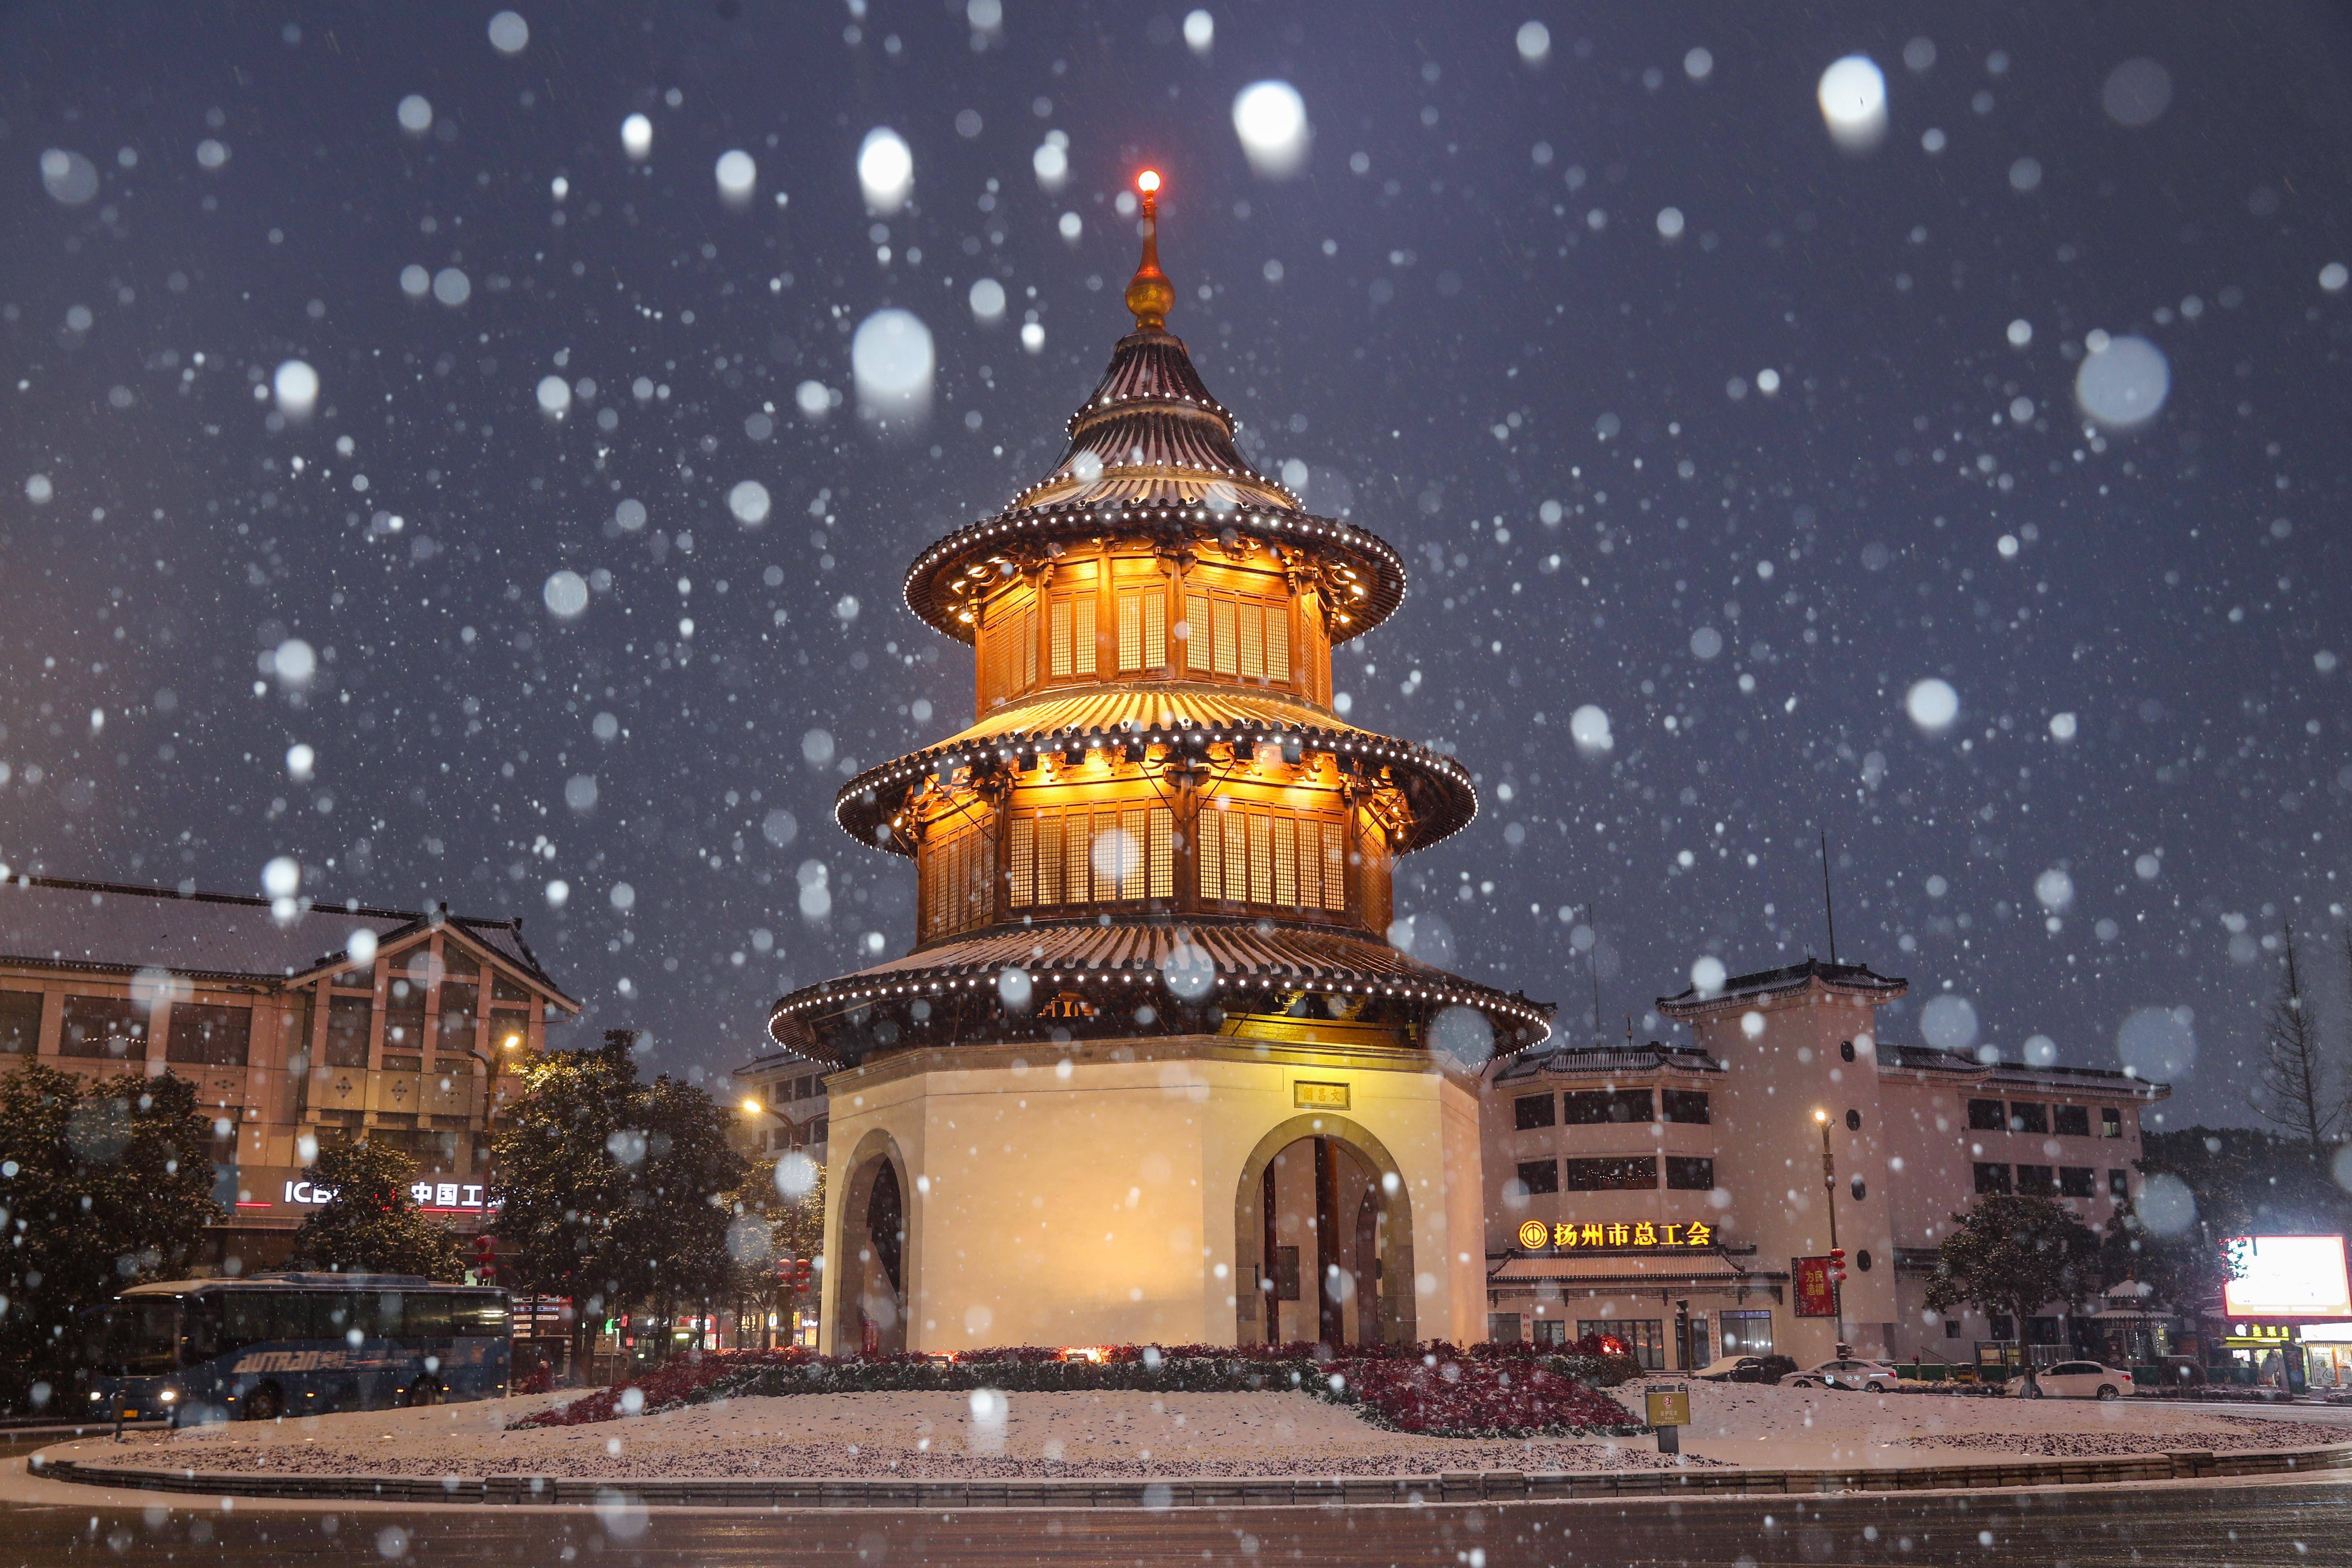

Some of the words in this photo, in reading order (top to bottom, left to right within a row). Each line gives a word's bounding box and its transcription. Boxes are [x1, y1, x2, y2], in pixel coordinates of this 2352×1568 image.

[1554, 1221, 1710, 1247] 扬州市总工会
[1806, 1271, 1824, 1282] 为民
[1807, 1283, 1825, 1295] 造福
